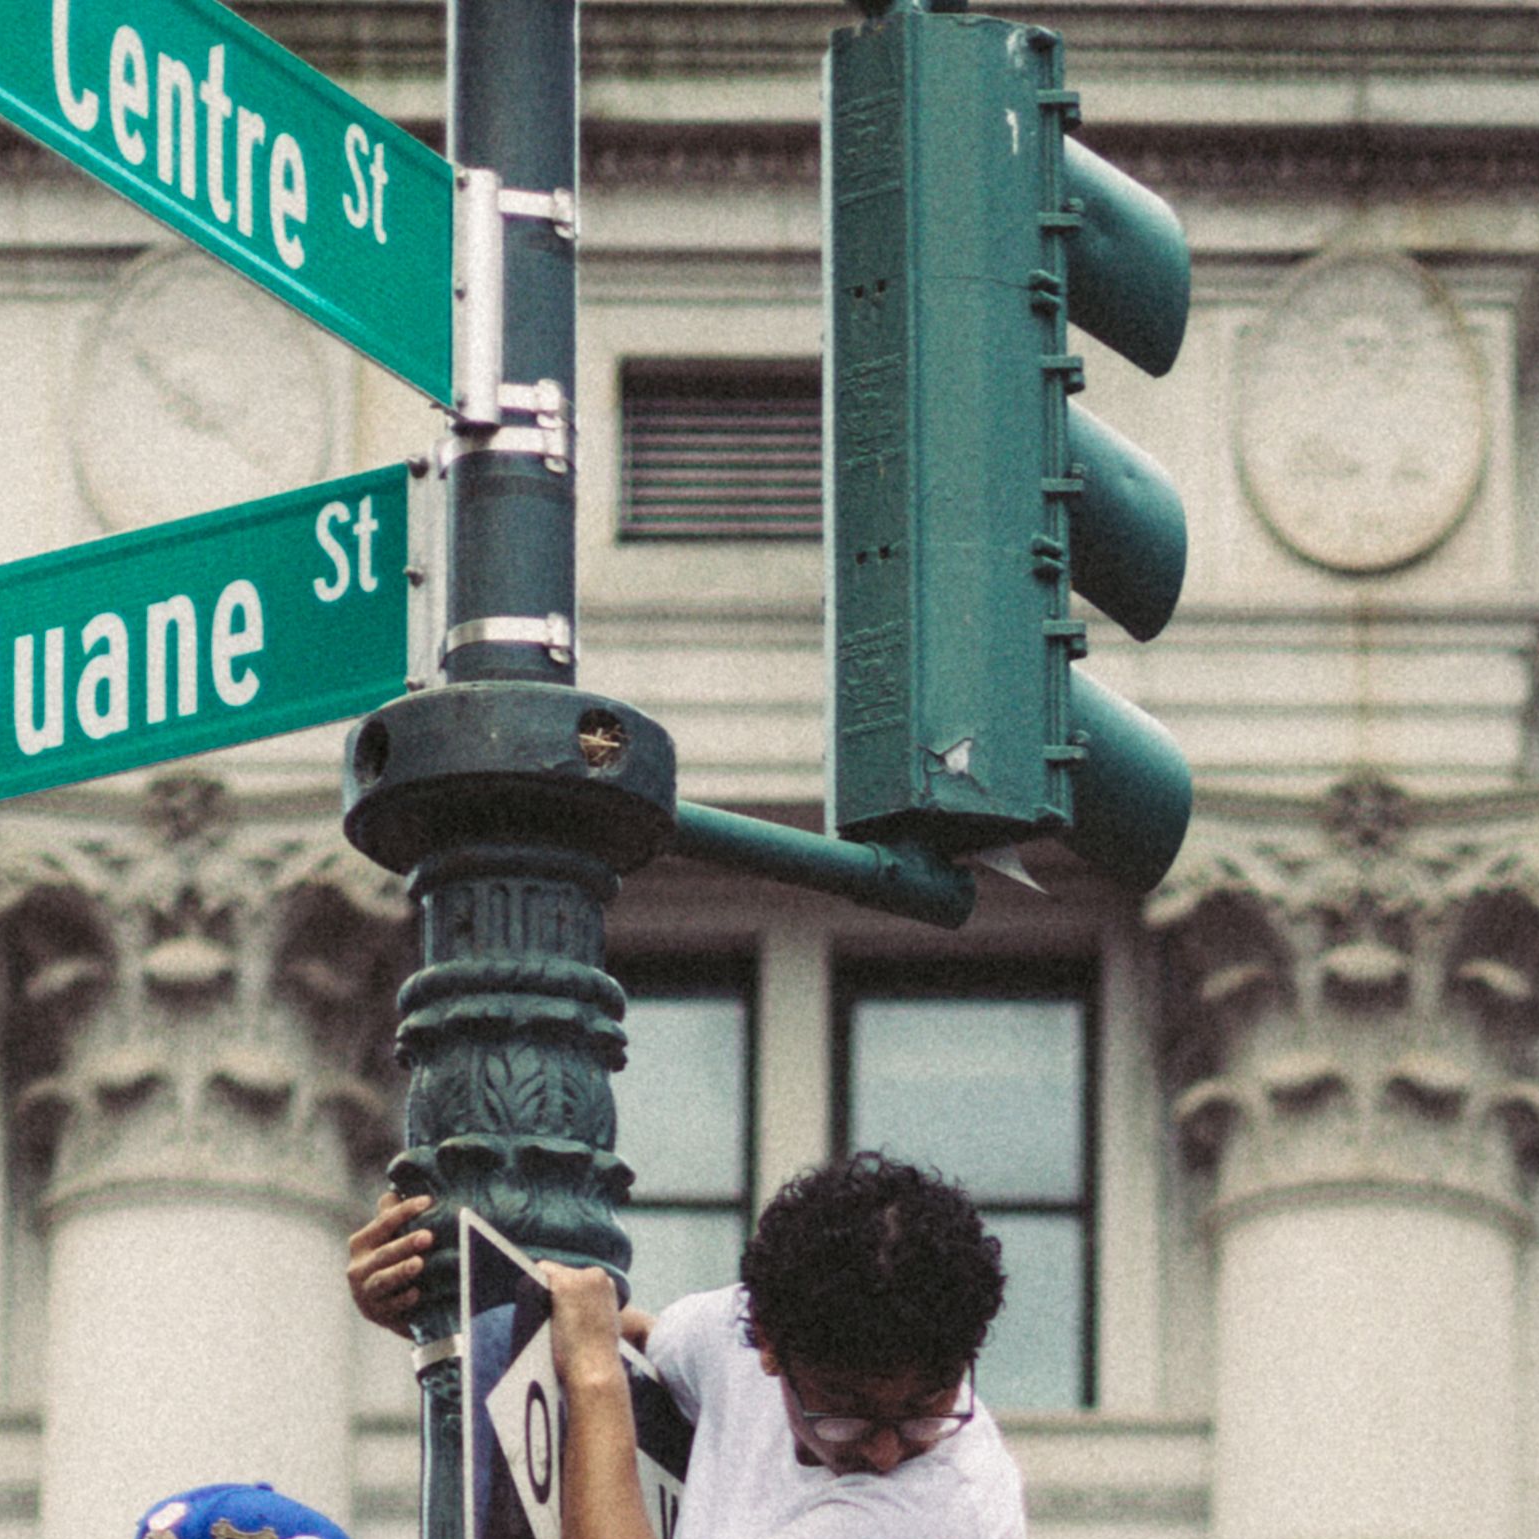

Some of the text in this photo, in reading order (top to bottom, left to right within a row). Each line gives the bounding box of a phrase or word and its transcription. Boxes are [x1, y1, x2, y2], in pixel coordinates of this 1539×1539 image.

[51, 0, 390, 270] Centre St
[312, 494, 379, 603] St
